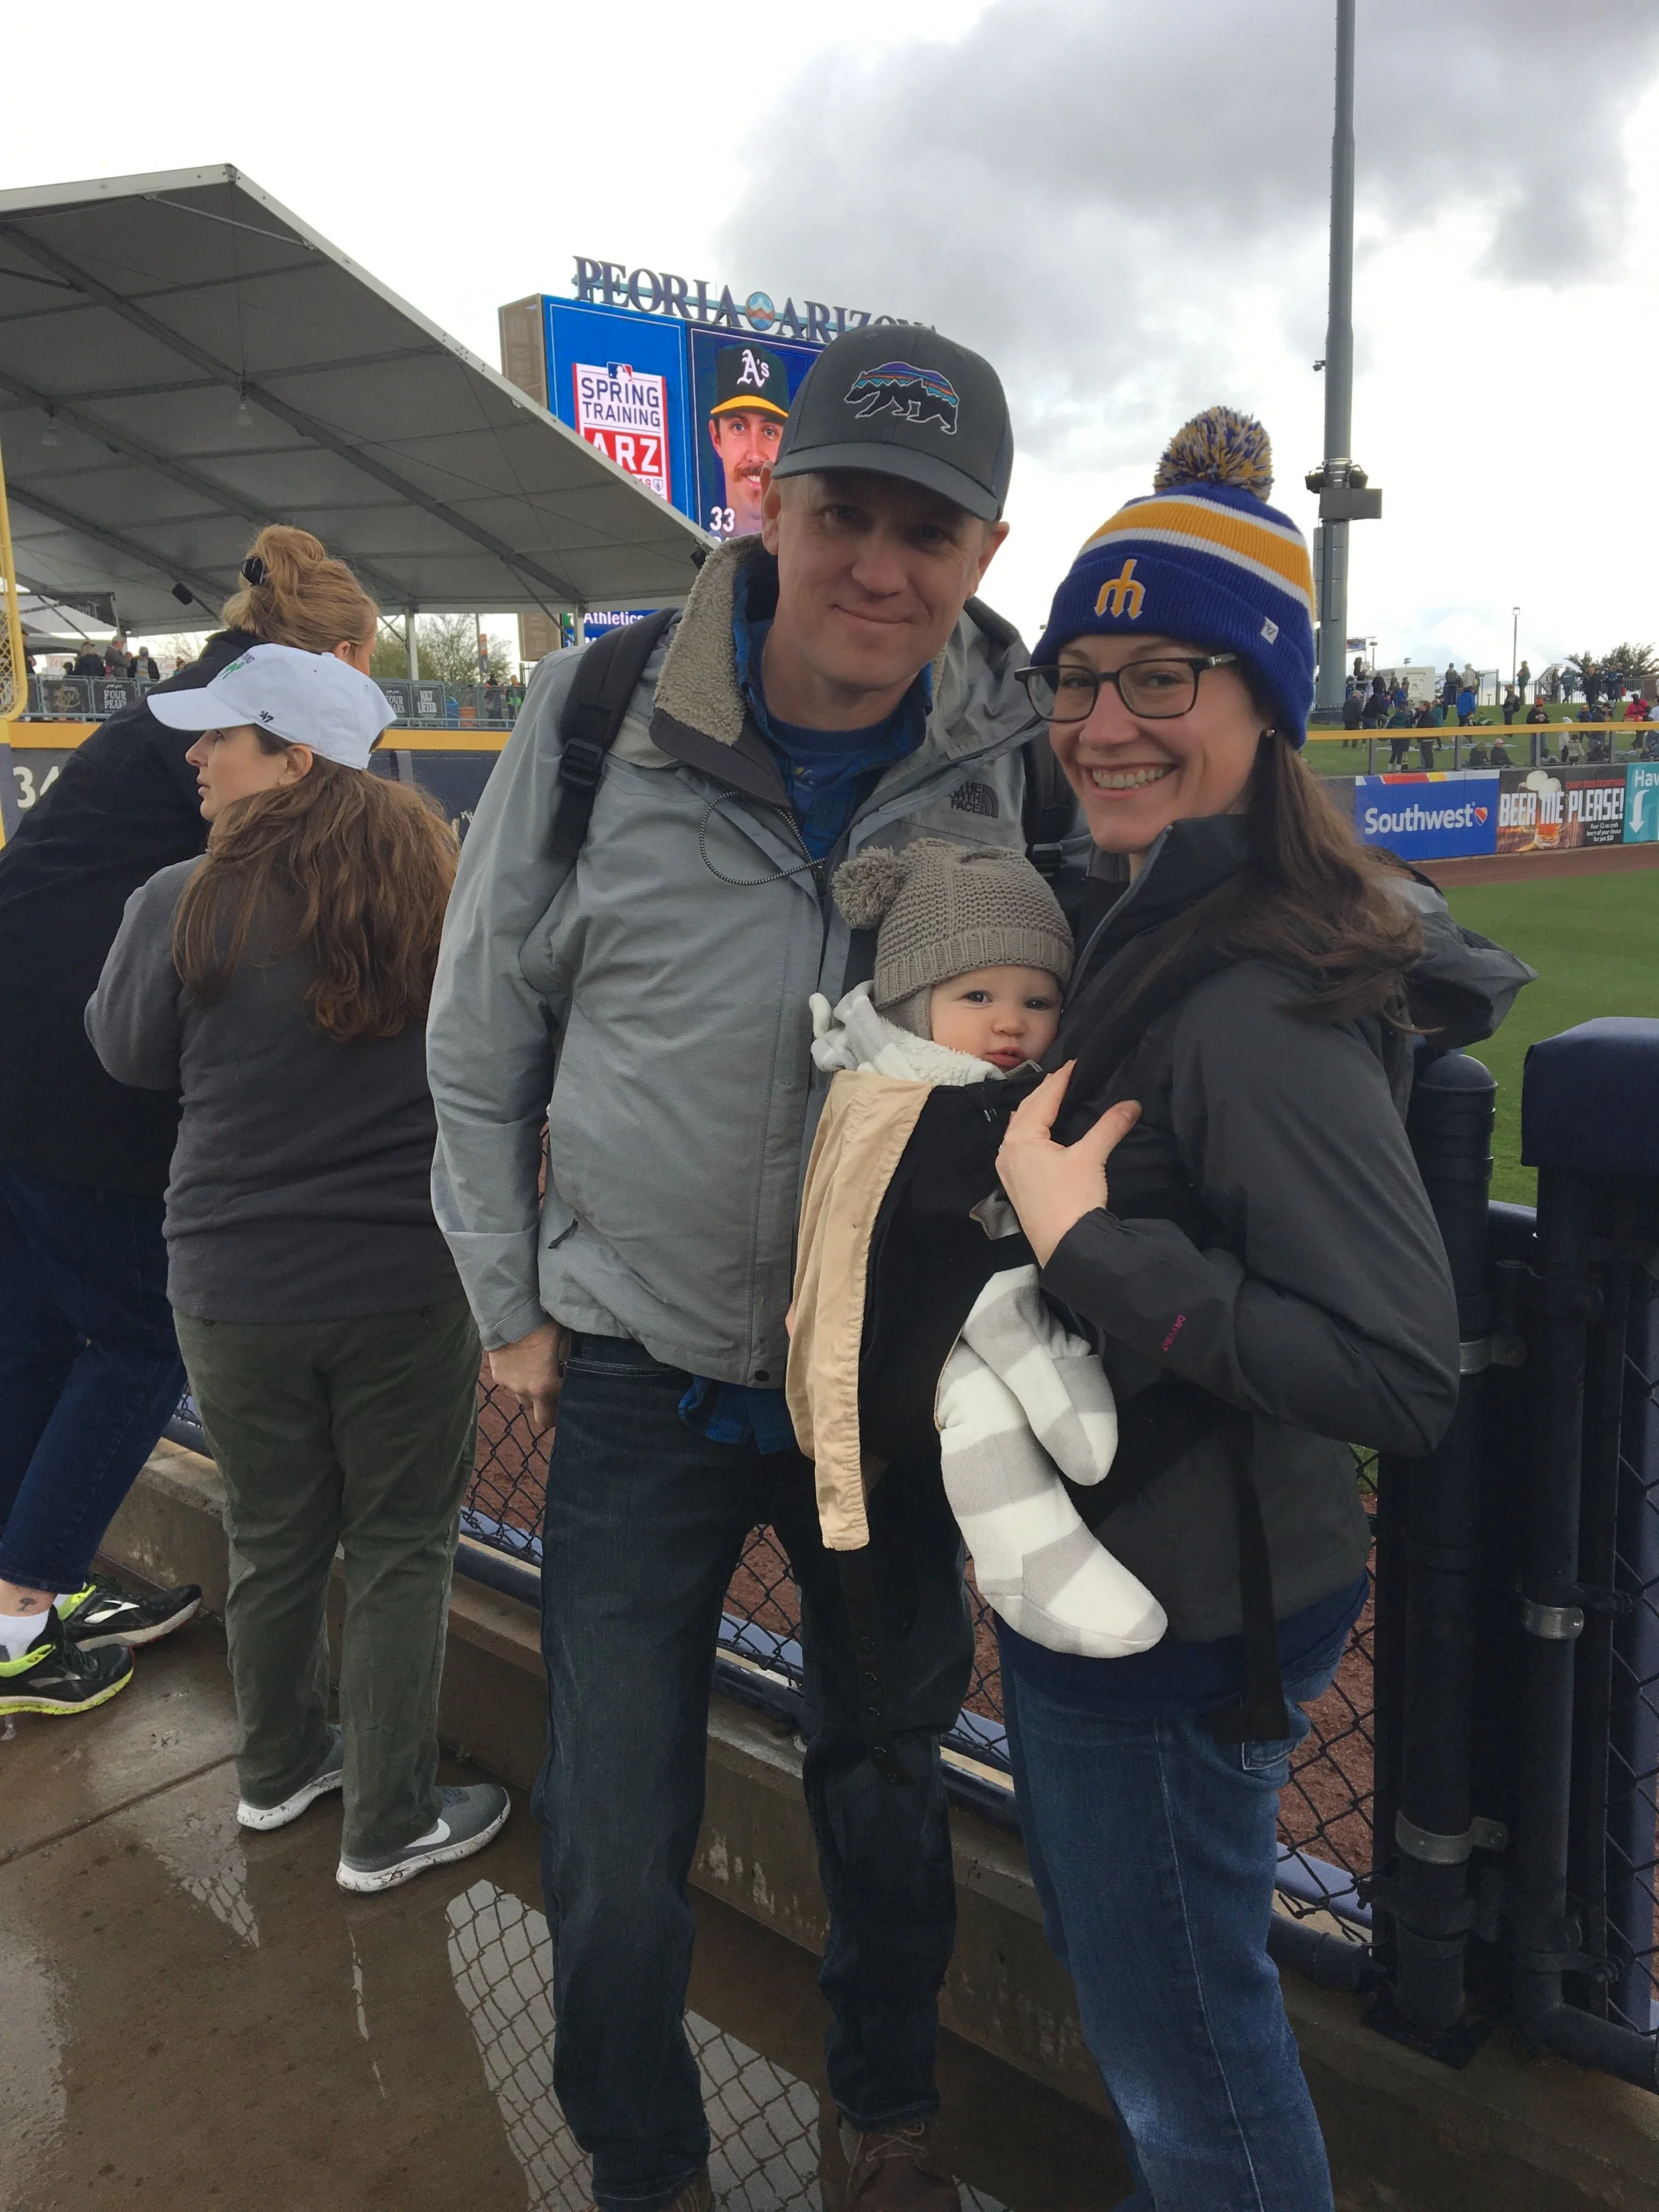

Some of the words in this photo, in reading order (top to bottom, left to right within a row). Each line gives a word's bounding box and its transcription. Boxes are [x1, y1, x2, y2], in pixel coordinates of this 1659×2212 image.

[572, 256, 744, 328] PEORIA
[775, 297, 937, 344] ARIZ
[737, 349, 770, 388] A's
[581, 377, 660, 407] SPRING
[582, 401, 661, 427] TRAINING
[593, 432, 659, 473] ARZ
[709, 506, 735, 532] 33
[583, 611, 644, 625] Athletics
[104, 690, 127, 701] FOUR
[390, 703, 405, 713] AKS
[417, 701, 437, 713] LIFTER
[419, 690, 433, 702] KILT
[951, 798, 981, 814] FACE
[1364, 803, 1473, 835] Southwest
[1499, 792, 1537, 827] BEER
[1540, 791, 1565, 824] ME
[1568, 788, 1624, 823] PLEASE!
